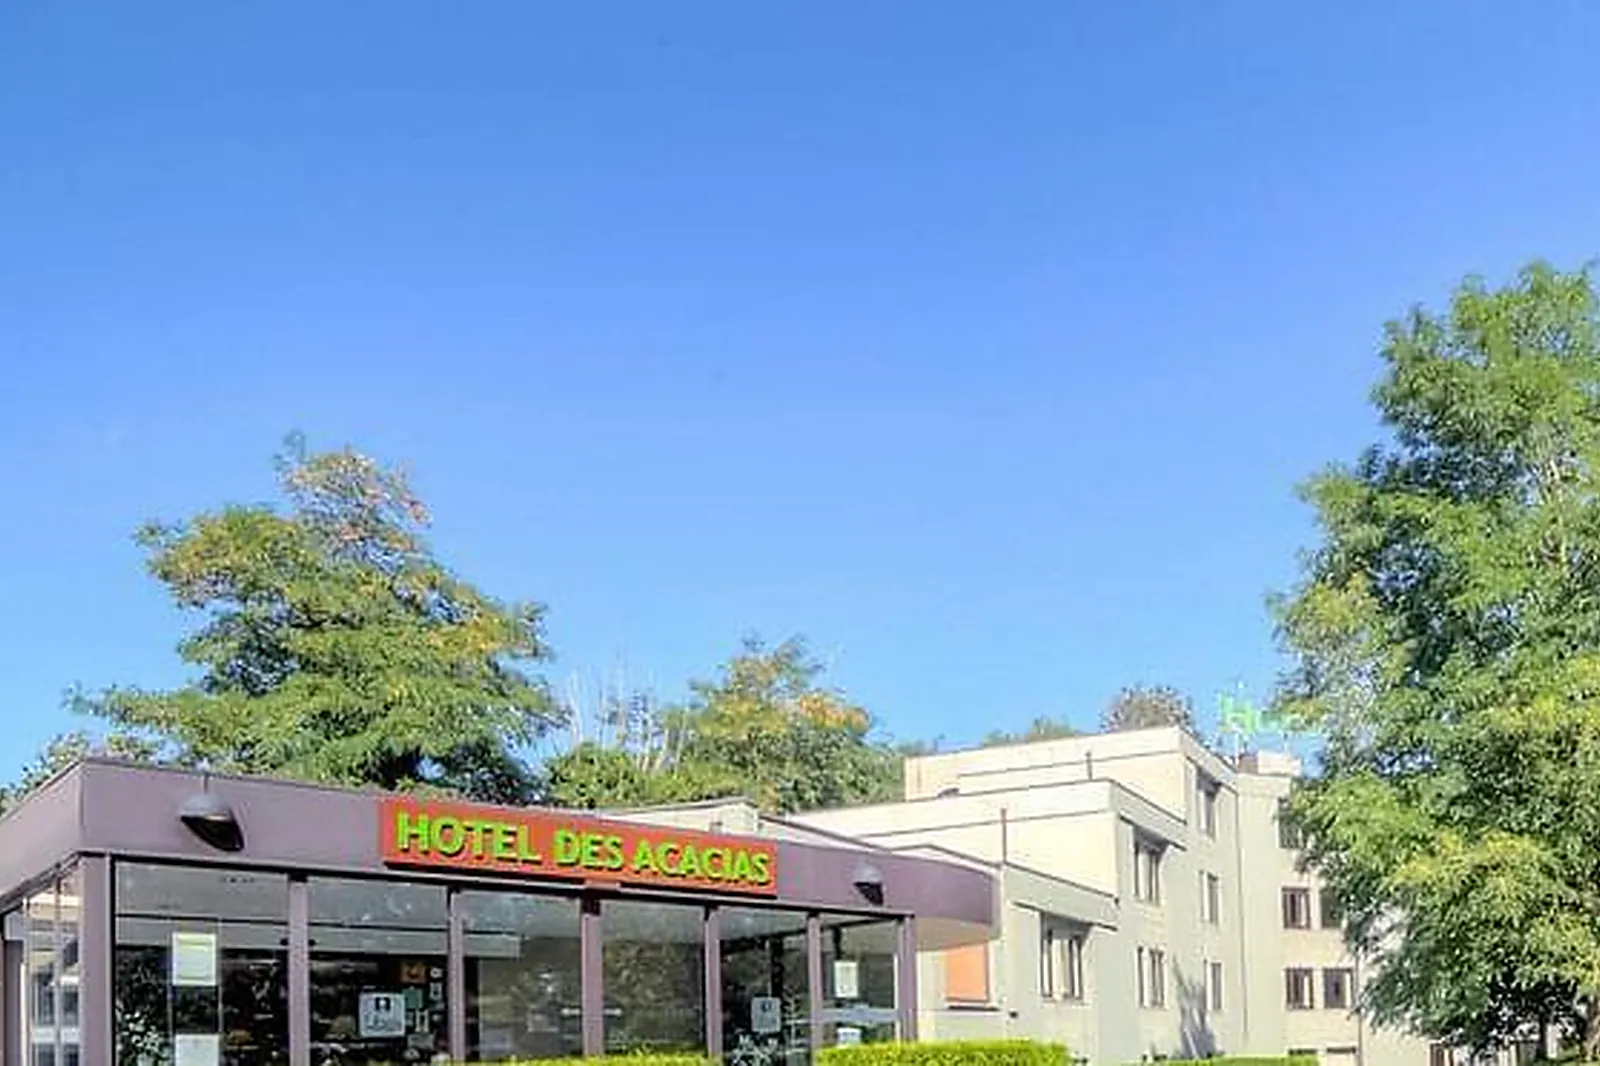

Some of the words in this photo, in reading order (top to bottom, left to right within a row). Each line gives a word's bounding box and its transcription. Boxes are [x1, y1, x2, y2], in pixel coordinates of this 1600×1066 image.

[396, 812, 541, 862] HOTEL
[554, 829, 624, 868] DES
[634, 839, 769, 883] ACACIAS
